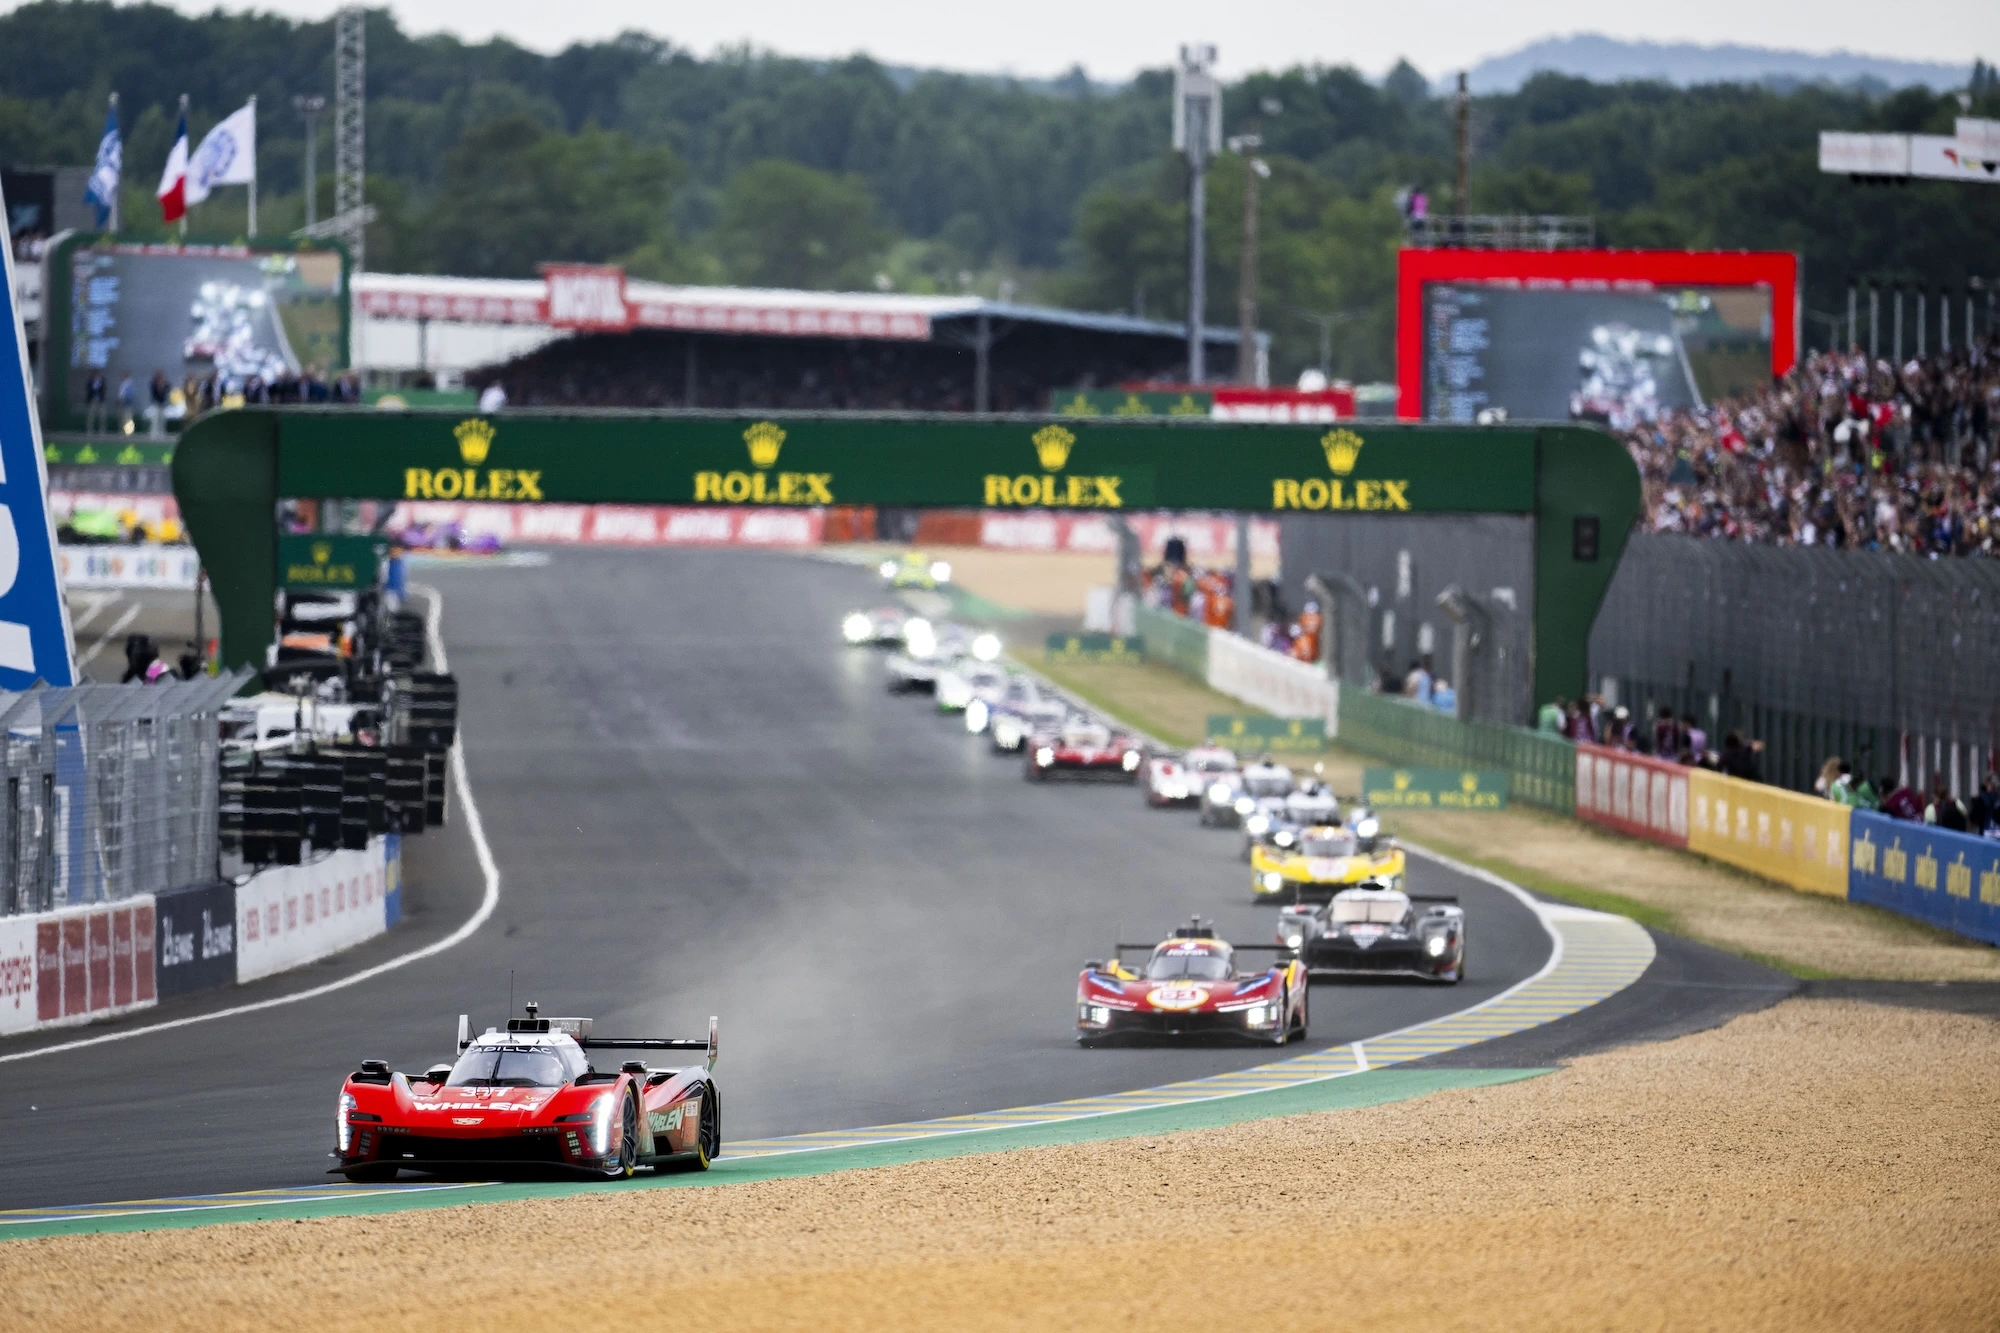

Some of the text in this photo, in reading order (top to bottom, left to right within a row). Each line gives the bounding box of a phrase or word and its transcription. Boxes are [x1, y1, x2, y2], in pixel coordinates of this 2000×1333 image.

[404, 467, 543, 499] ROLEX
[693, 470, 833, 502] ROLEX
[983, 474, 1121, 506] ROLEX
[1273, 477, 1410, 510] ROLEX
[0, 941, 31, 1009] nergies
[561, 1022, 580, 1032] CADILLAC
[413, 1101, 539, 1111] WHELEN
[647, 1104, 684, 1133] WHELEN
